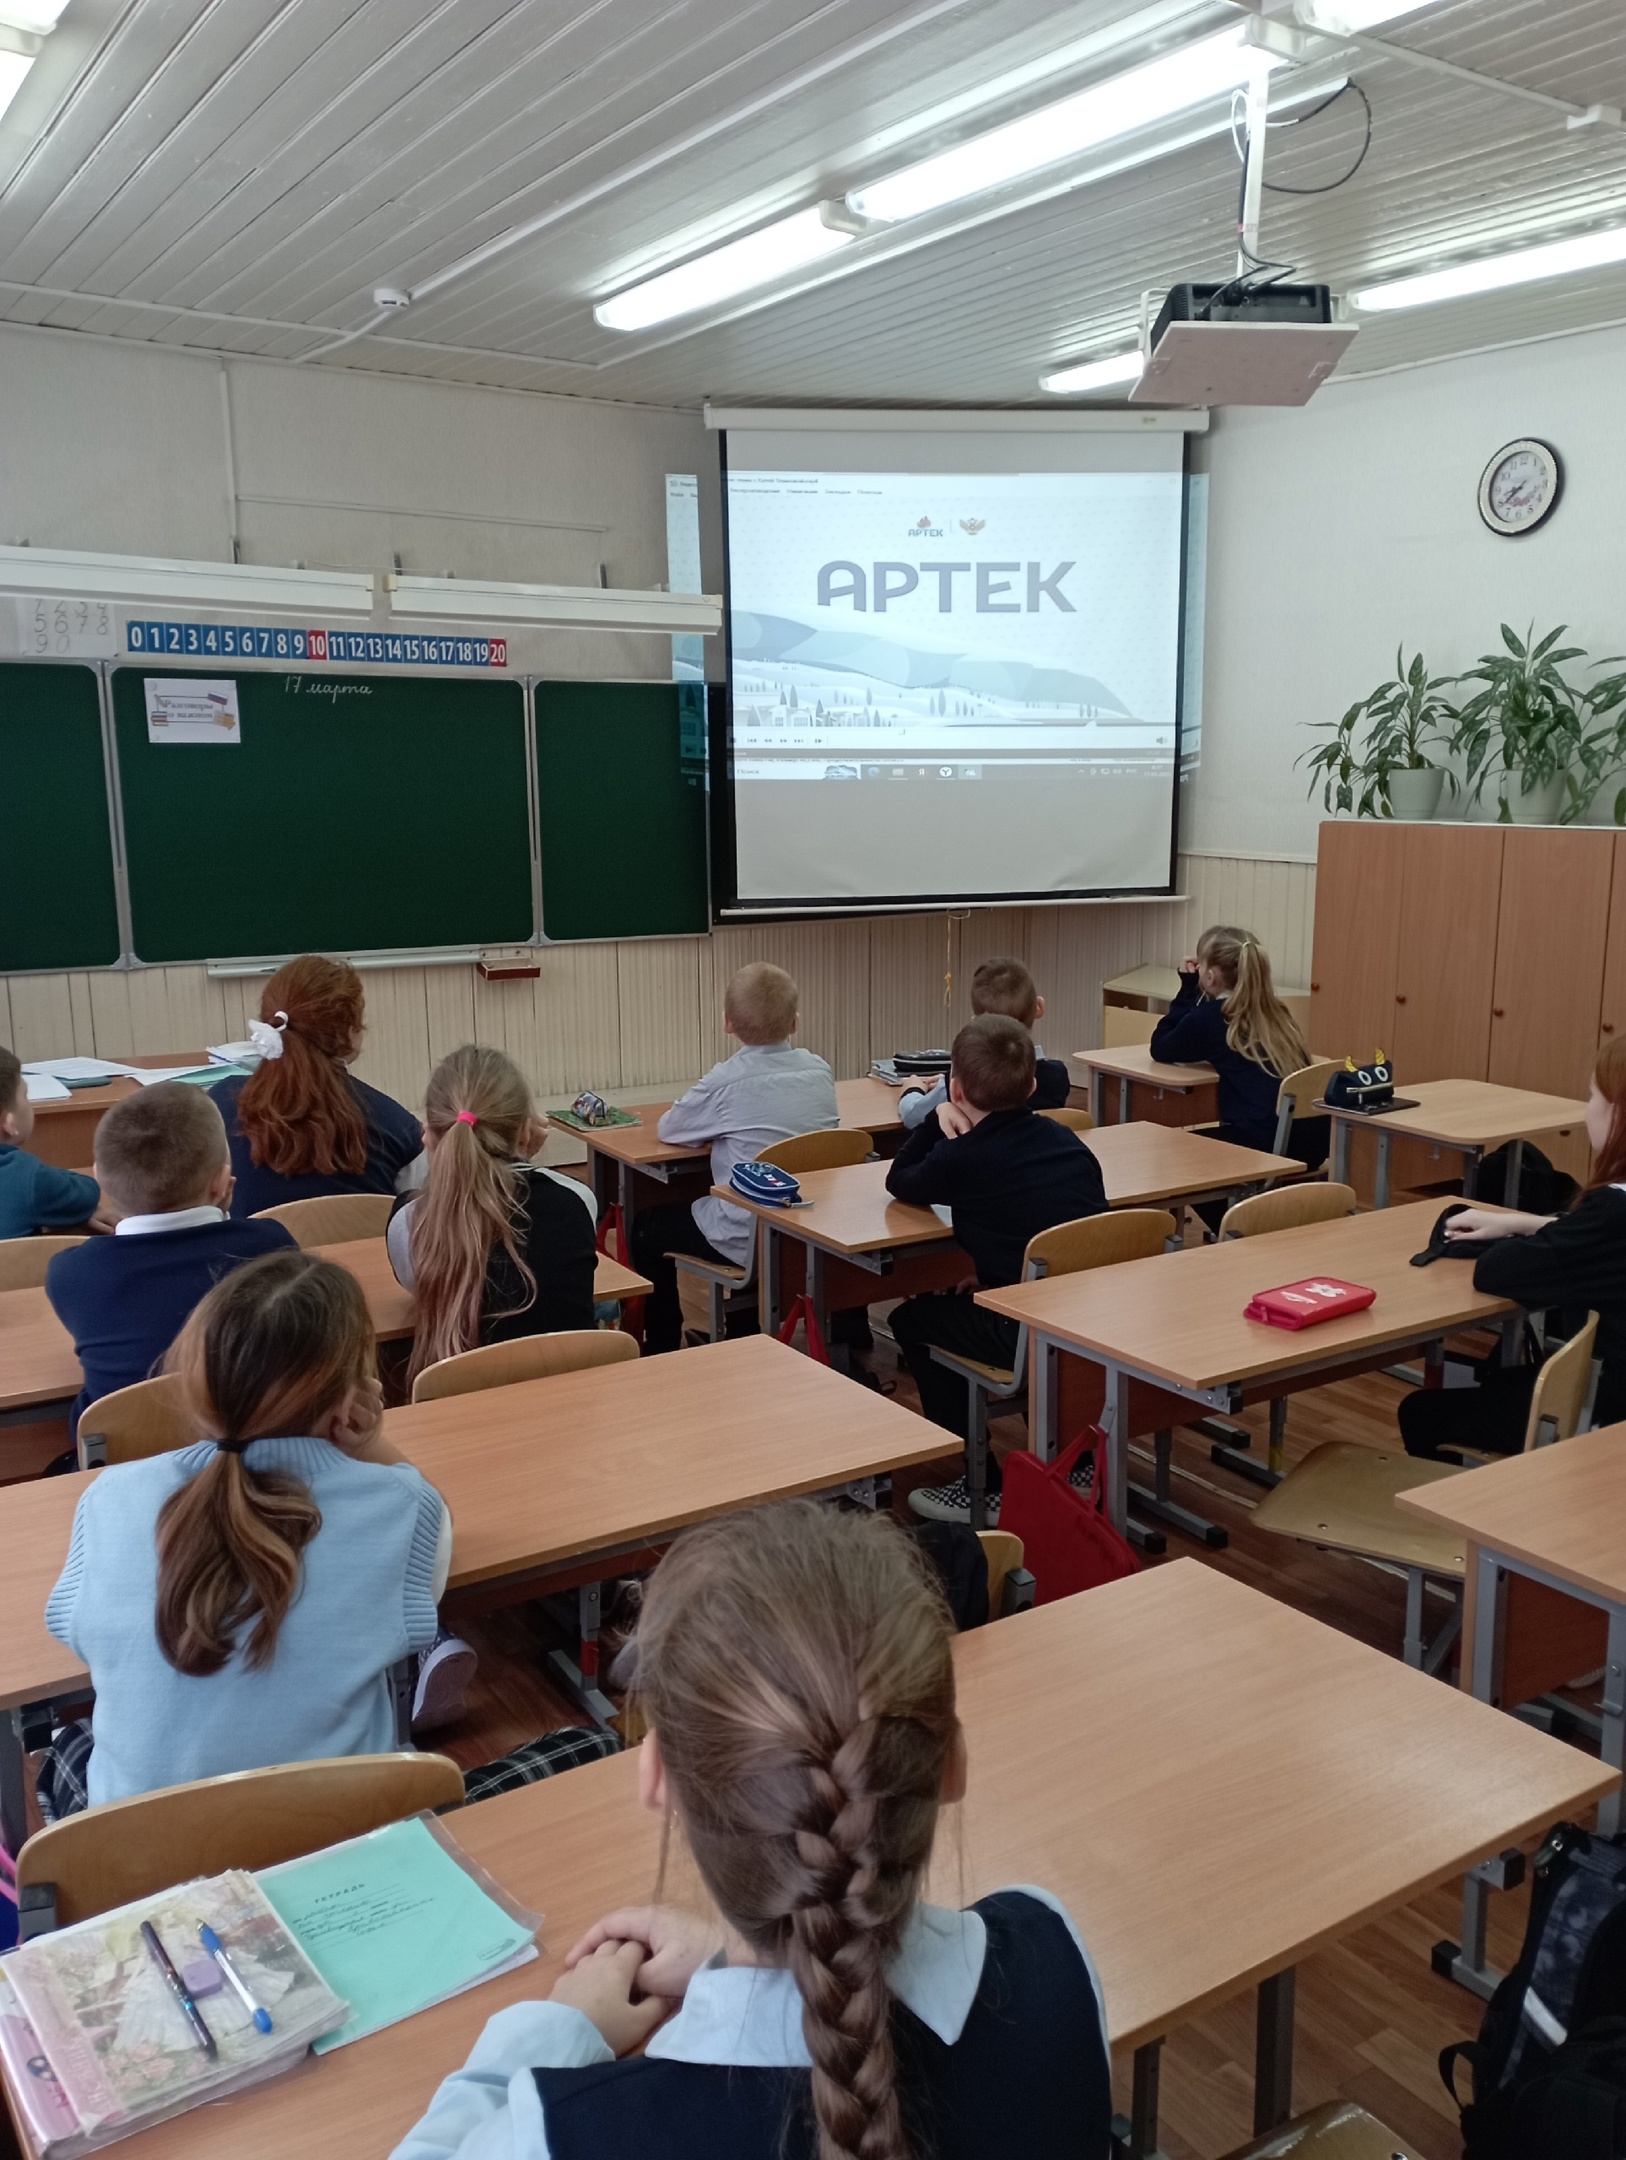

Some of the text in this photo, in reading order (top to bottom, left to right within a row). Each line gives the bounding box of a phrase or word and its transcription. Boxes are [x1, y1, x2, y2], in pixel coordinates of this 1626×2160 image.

[908, 529, 943, 537] АРТЕК
[817, 560, 1077, 612] АРТЕК
[34, 613, 109, 635] 5 6 7 8
[35, 633, 70, 654] 9 0
[131, 626, 506, 663] 0 1 2 3 4 5 6 7 8 9 10 11 12 13 14 15 16 17 18 19 20
[284, 675, 373, 703] 17 марта
[165, 700, 213, 711] Разговоры
